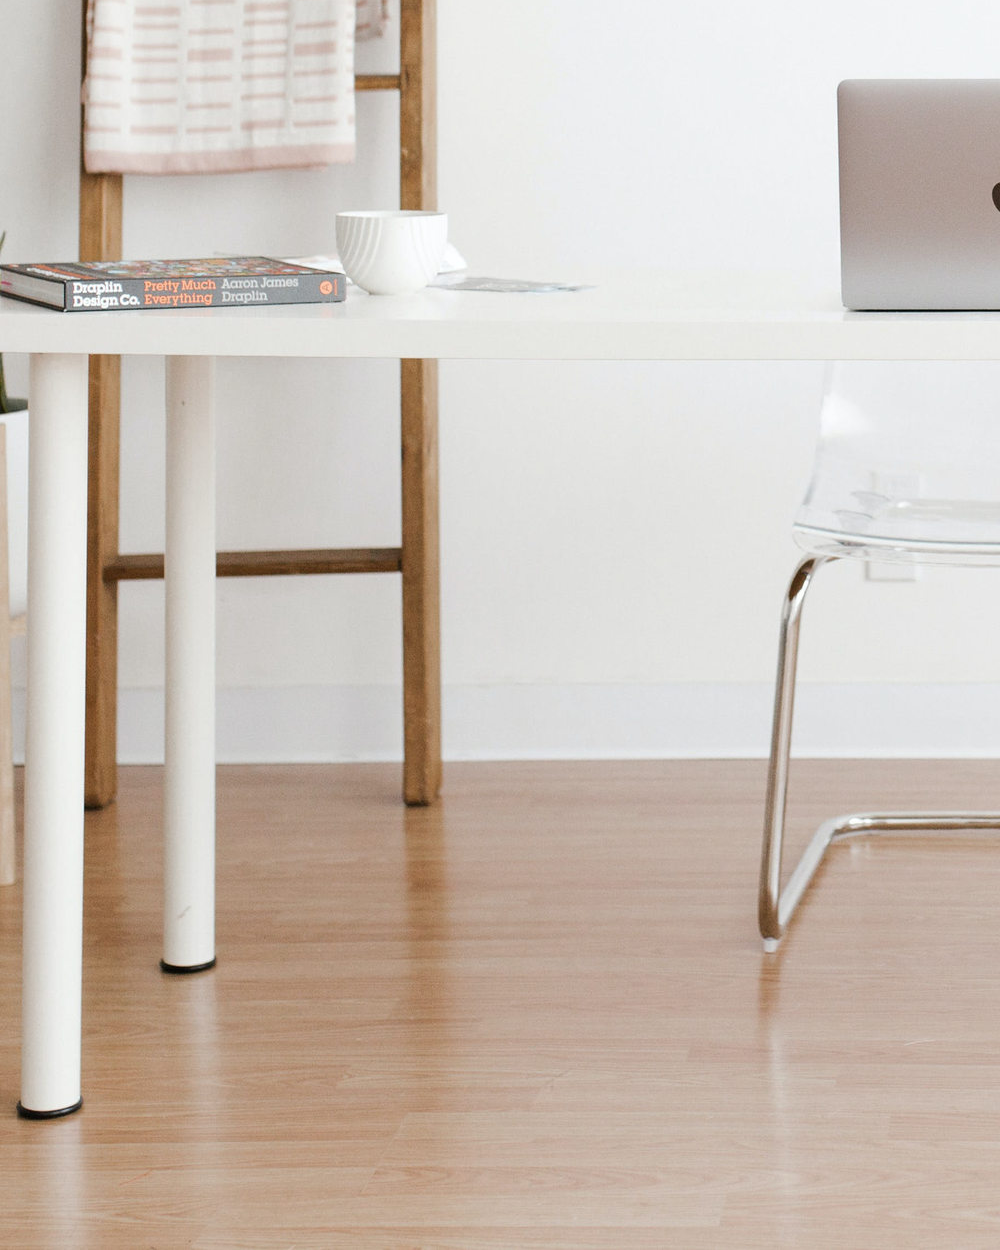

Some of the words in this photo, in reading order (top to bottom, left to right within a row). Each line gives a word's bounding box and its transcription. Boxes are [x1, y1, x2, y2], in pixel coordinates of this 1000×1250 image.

[72, 281, 123, 295] Draplin
[144, 280, 180, 293] Pretty
[181, 279, 217, 290] Much
[220, 278, 259, 289] Aaron
[260, 277, 299, 288] James
[72, 295, 119, 309] Design
[119, 293, 140, 306] Co.
[144, 292, 214, 306] Everything
[221, 290, 268, 303] Draplin
